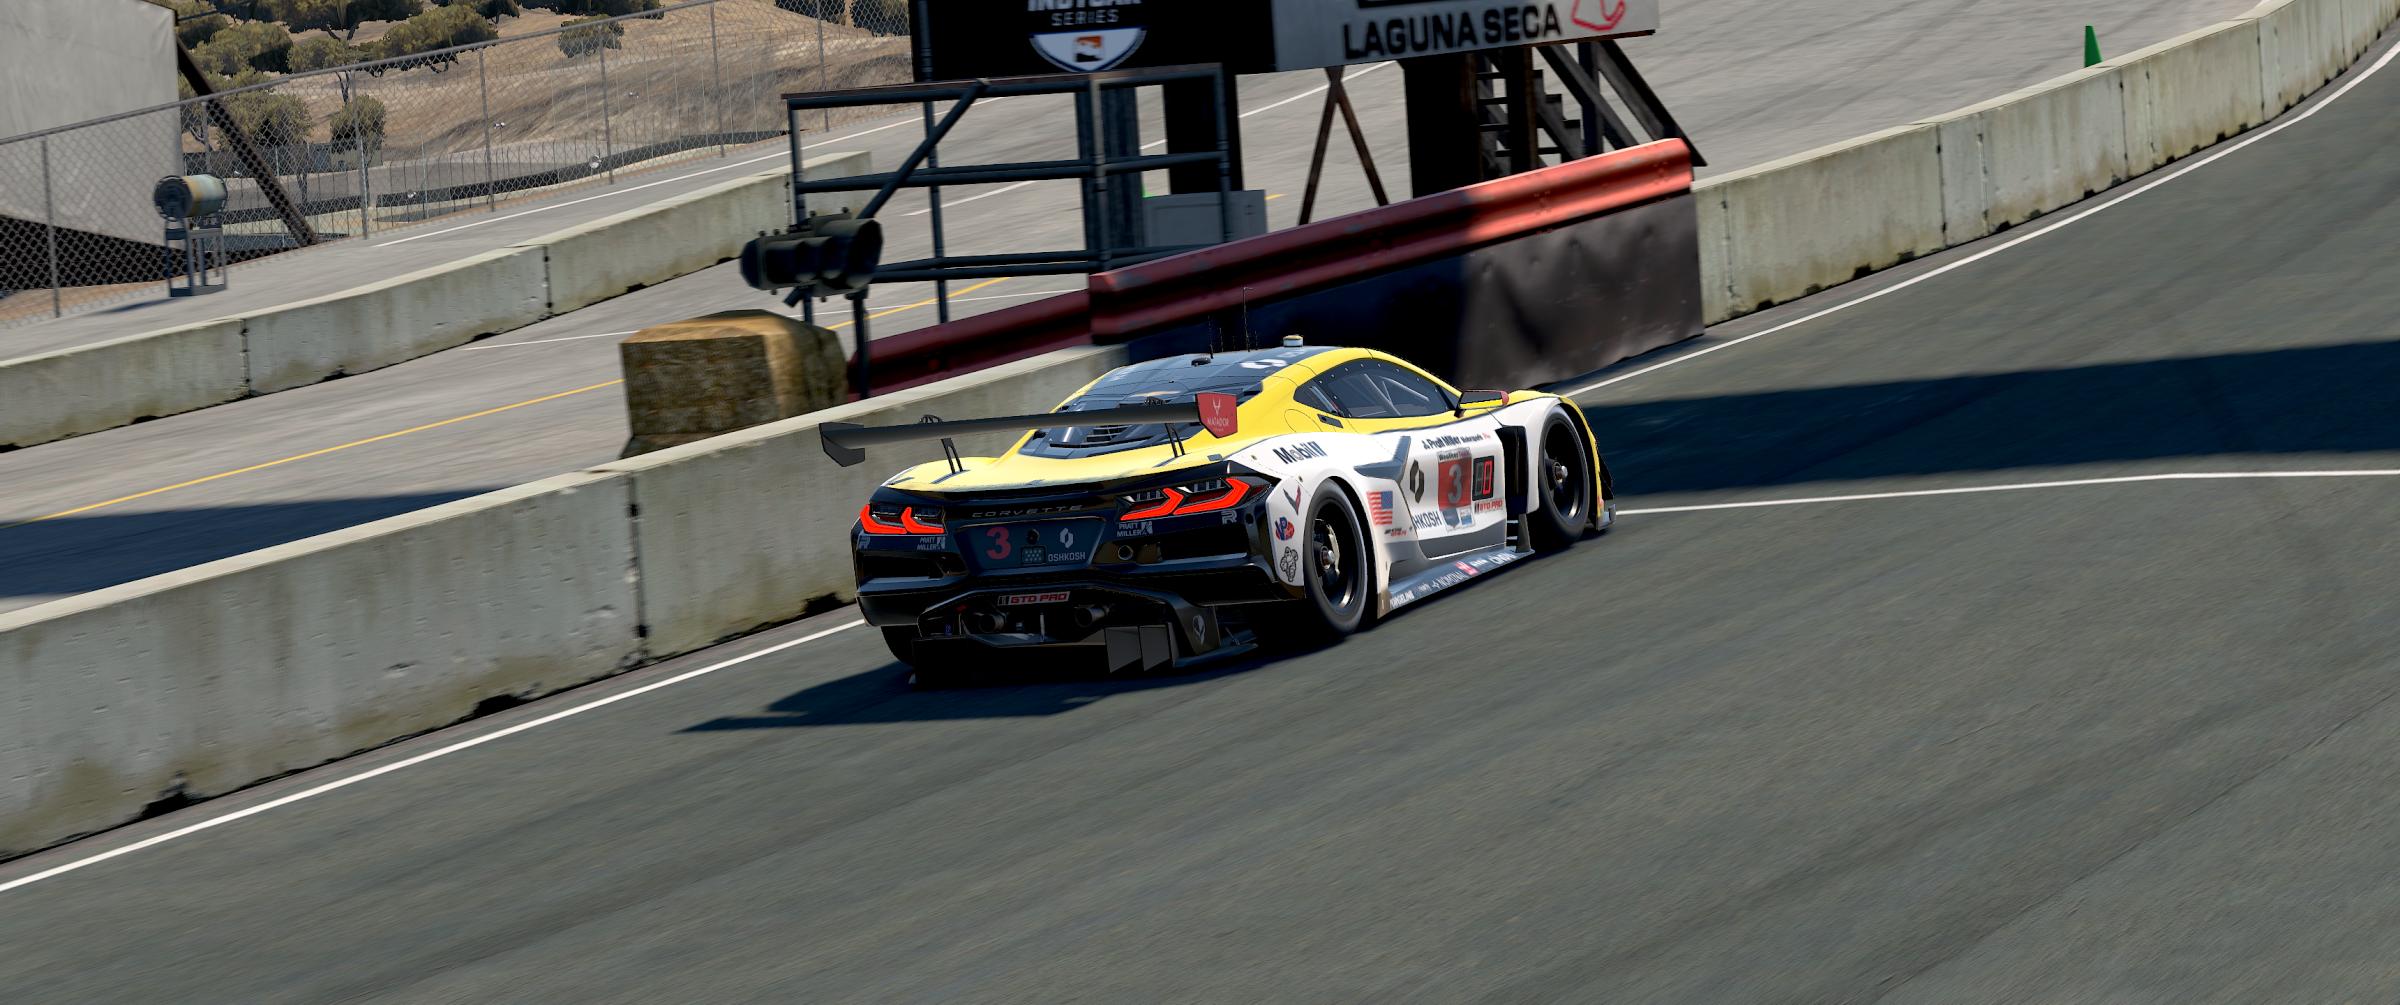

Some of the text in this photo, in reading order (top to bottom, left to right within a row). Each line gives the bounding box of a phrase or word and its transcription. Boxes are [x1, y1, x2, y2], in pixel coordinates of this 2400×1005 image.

[1051, 9, 1119, 26] SERIES
[1343, 4, 1562, 60] LAGUNA SECA
[1447, 463, 1462, 504] 3
[972, 505, 1083, 518] CORVETTE
[1118, 522, 1139, 531] PRATT
[1116, 529, 1142, 538] MILLER
[916, 543, 937, 551] MILLER
[986, 526, 1012, 560] 3
[1048, 552, 1086, 562] OSHKOSH
[1010, 593, 1038, 605] GTD
[1039, 592, 1067, 603] PRO
